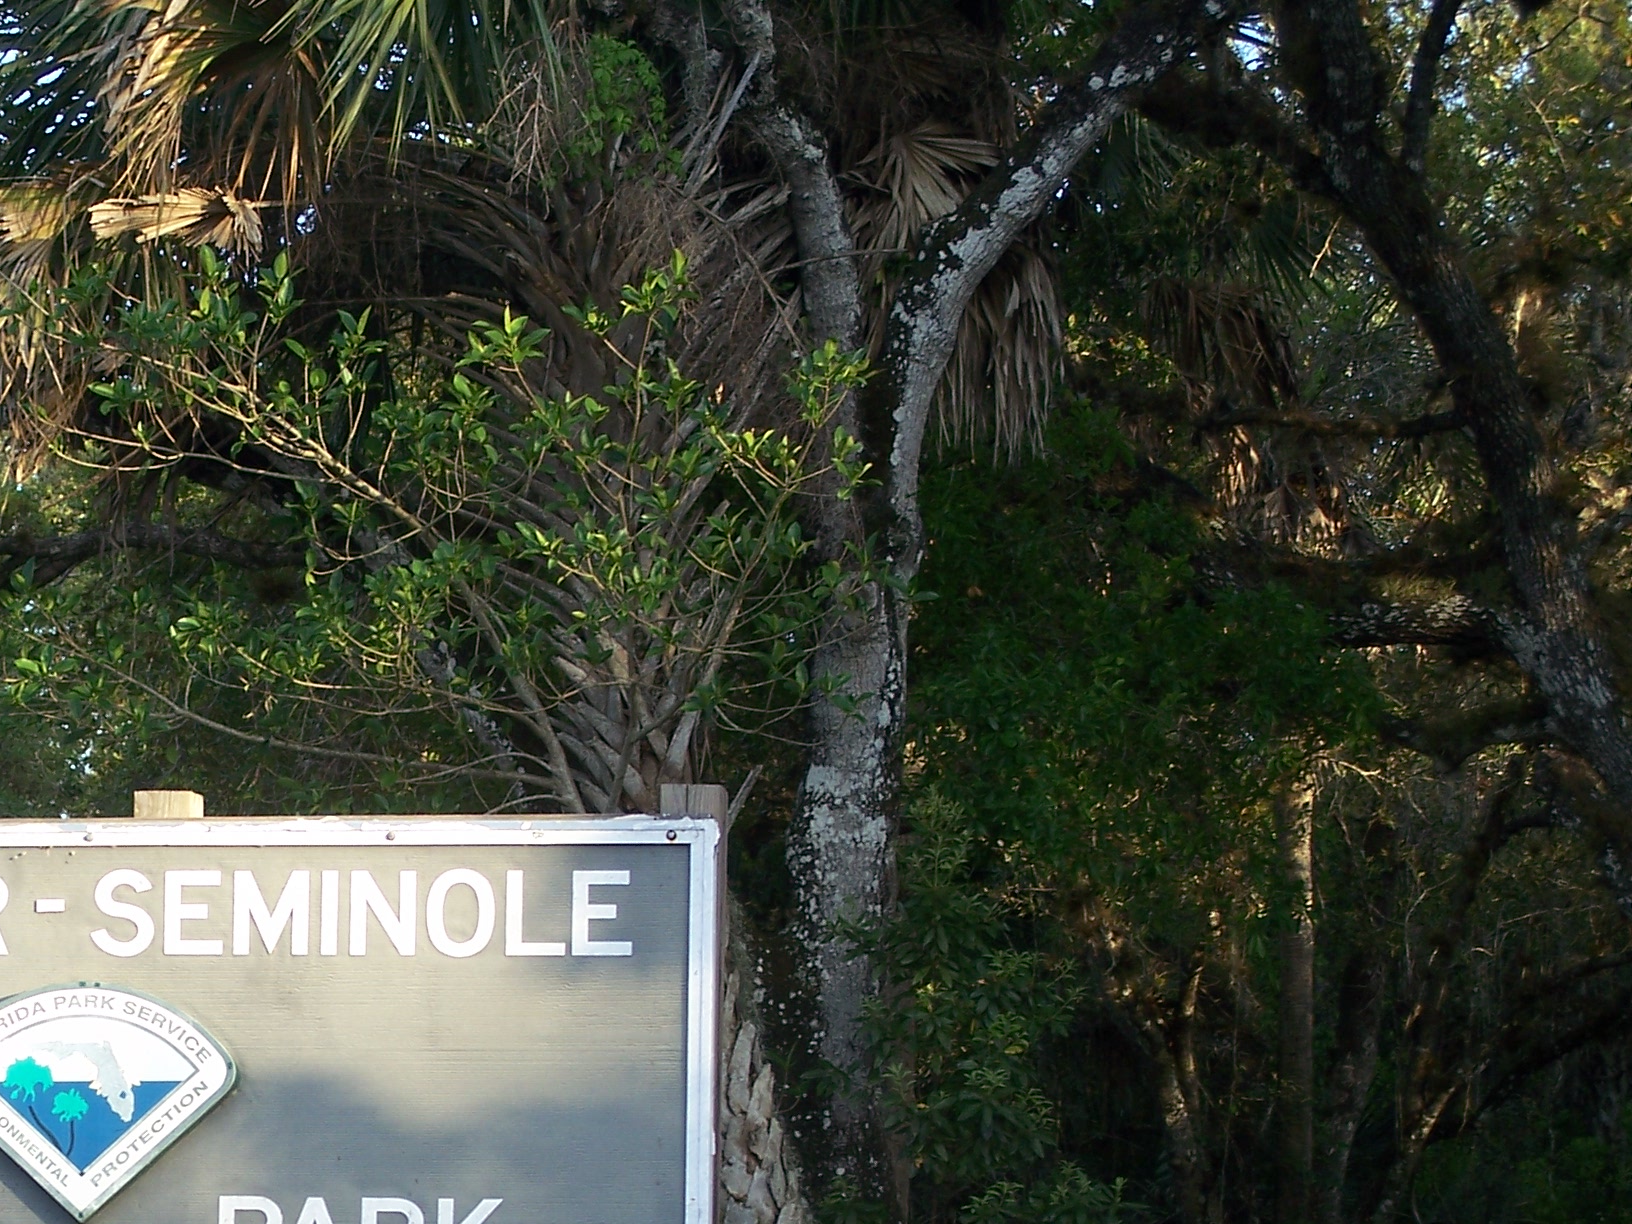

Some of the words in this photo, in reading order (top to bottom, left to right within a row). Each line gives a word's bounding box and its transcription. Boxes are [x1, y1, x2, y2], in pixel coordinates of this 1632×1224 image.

[89, 867, 633, 958] SEMINOLE
[54, 994, 116, 1011] PARK
[122, 1000, 212, 1064] SERVICE
[89, 1080, 210, 1188] PROTECTION
